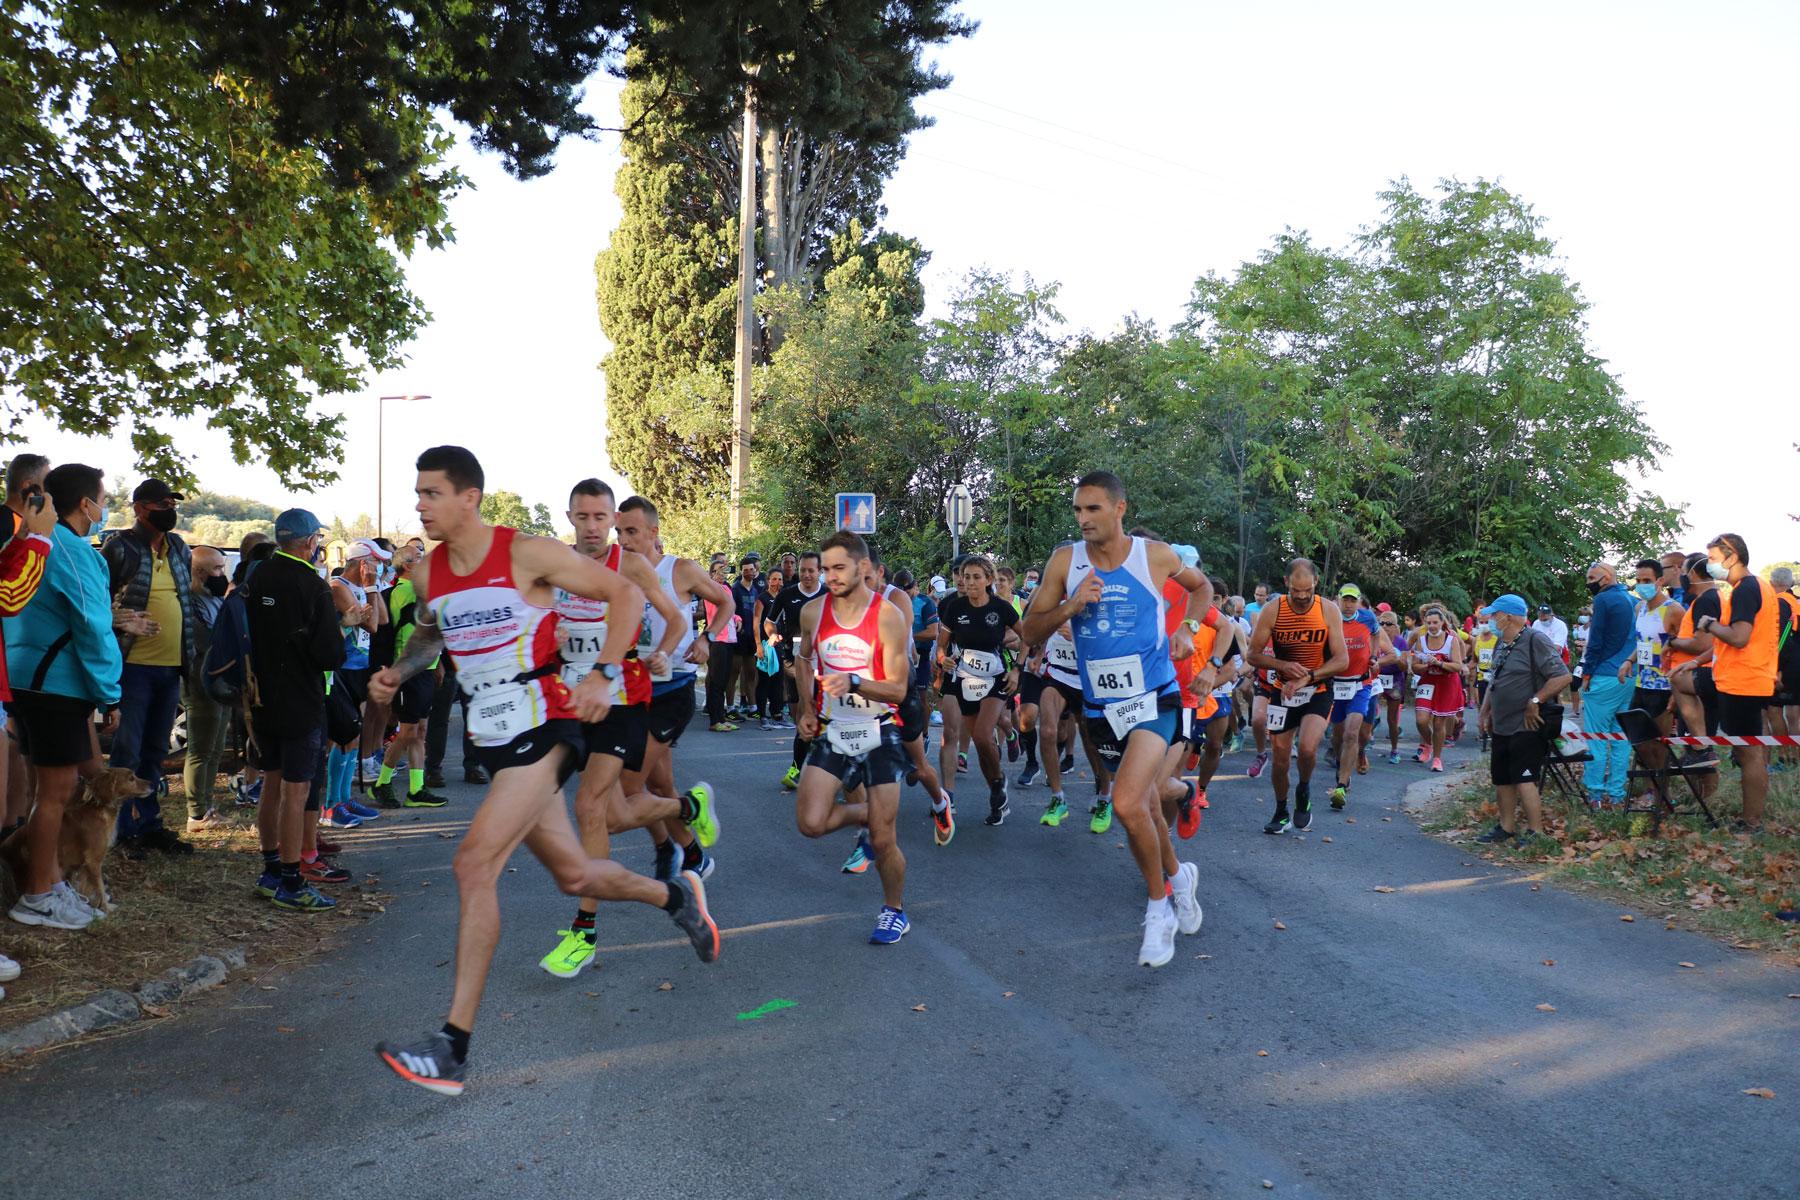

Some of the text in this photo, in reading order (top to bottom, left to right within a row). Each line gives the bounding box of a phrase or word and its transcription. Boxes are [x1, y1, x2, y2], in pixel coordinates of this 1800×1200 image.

[568, 636, 600, 653] 17.1
[968, 658, 991, 672] 45.1
[1098, 671, 1133, 689] 48.1
[839, 694, 871, 708] 14.1
[480, 701, 516, 719] EQUIPE
[1116, 701, 1145, 717] EQUIPE
[1125, 715, 1137, 724] 48
[840, 730, 868, 740] EQUIPE
[850, 743, 860, 751] 14
